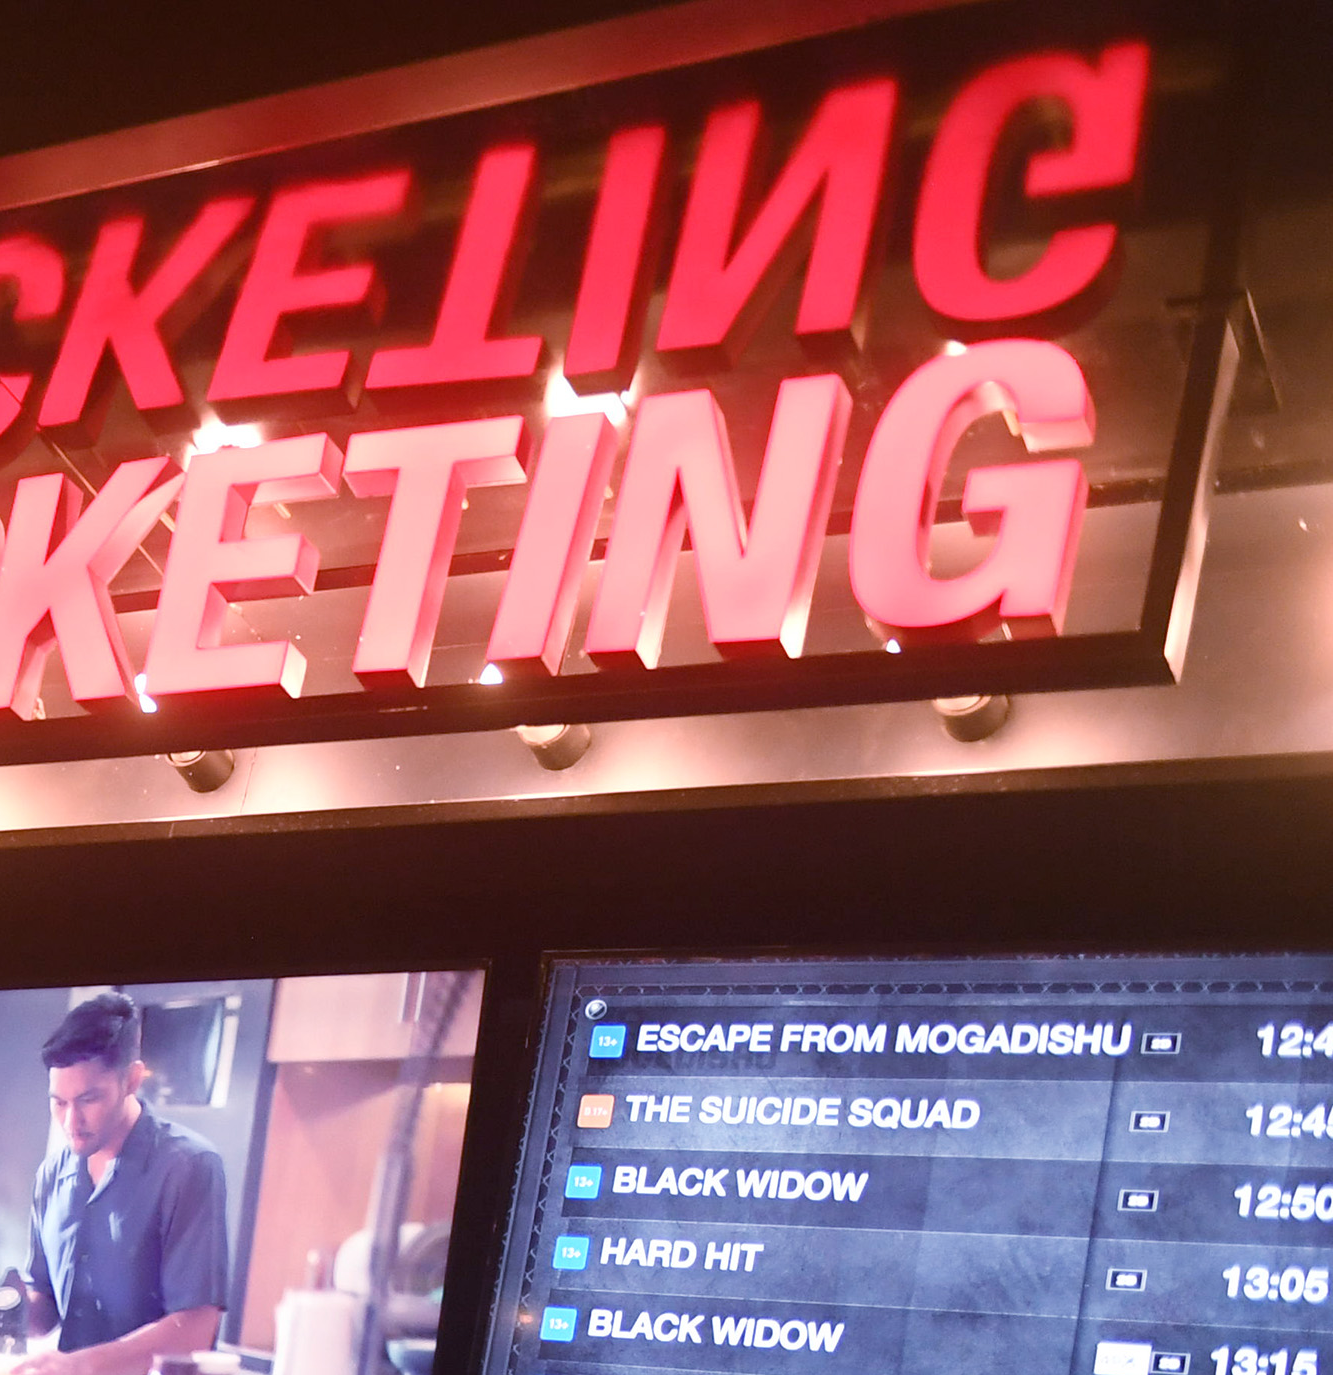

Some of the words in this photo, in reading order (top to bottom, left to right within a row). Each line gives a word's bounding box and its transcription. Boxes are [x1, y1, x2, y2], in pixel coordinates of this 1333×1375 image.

[598, 1036, 618, 1047] 13+
[636, 1023, 774, 1055] ESCAPE
[779, 1023, 888, 1054] FROM
[893, 1021, 1133, 1057] MOGADISHU
[625, 1094, 693, 1124] THE
[698, 1097, 841, 1127] SUICIDE
[847, 1098, 982, 1131] SQUAD
[1245, 1102, 1333, 1139] 12:4
[574, 1176, 594, 1187] 13+
[612, 1165, 731, 1198] BLACK
[735, 1168, 870, 1203] WIDOW
[1233, 1181, 1333, 1222] 12:50
[561, 1247, 582, 1258] 13+
[599, 1236, 698, 1270] HARD
[703, 1241, 765, 1273] HIT
[1221, 1264, 1330, 1303] 13:05
[548, 1318, 569, 1330] 13+
[586, 1308, 706, 1345] BLACK
[710, 1316, 846, 1353] WIDOW
